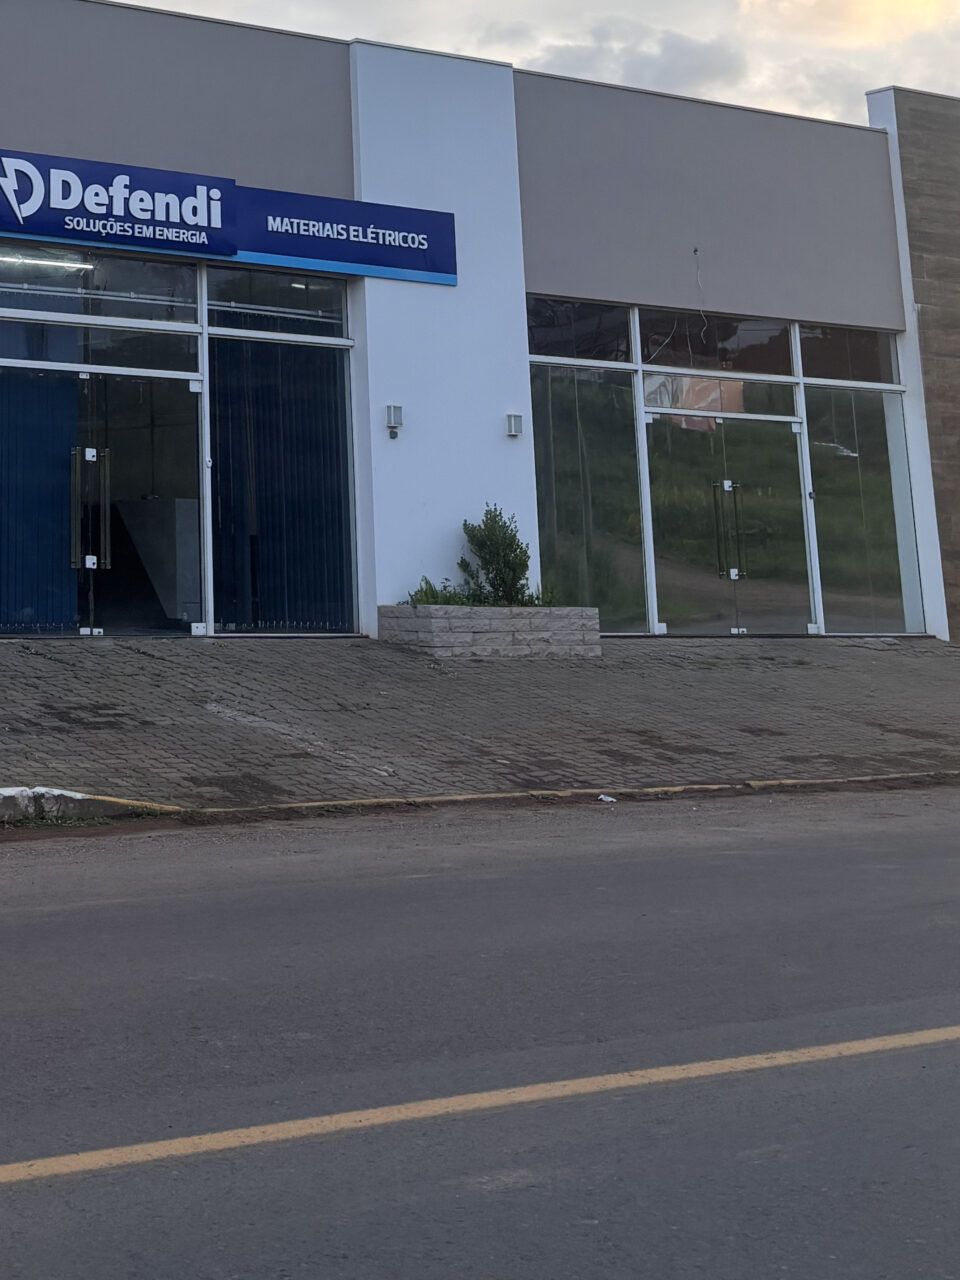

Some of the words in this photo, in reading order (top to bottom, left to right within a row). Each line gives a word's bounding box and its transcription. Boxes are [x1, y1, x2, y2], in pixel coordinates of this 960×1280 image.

[49, 168, 222, 229] Defendi
[64, 216, 133, 237] SOLUÇÕES
[134, 224, 154, 238] EM
[155, 226, 209, 245] ENERGIA
[267, 215, 347, 240] MATERIAIS
[349, 224, 429, 250] ELÉTRICOS
